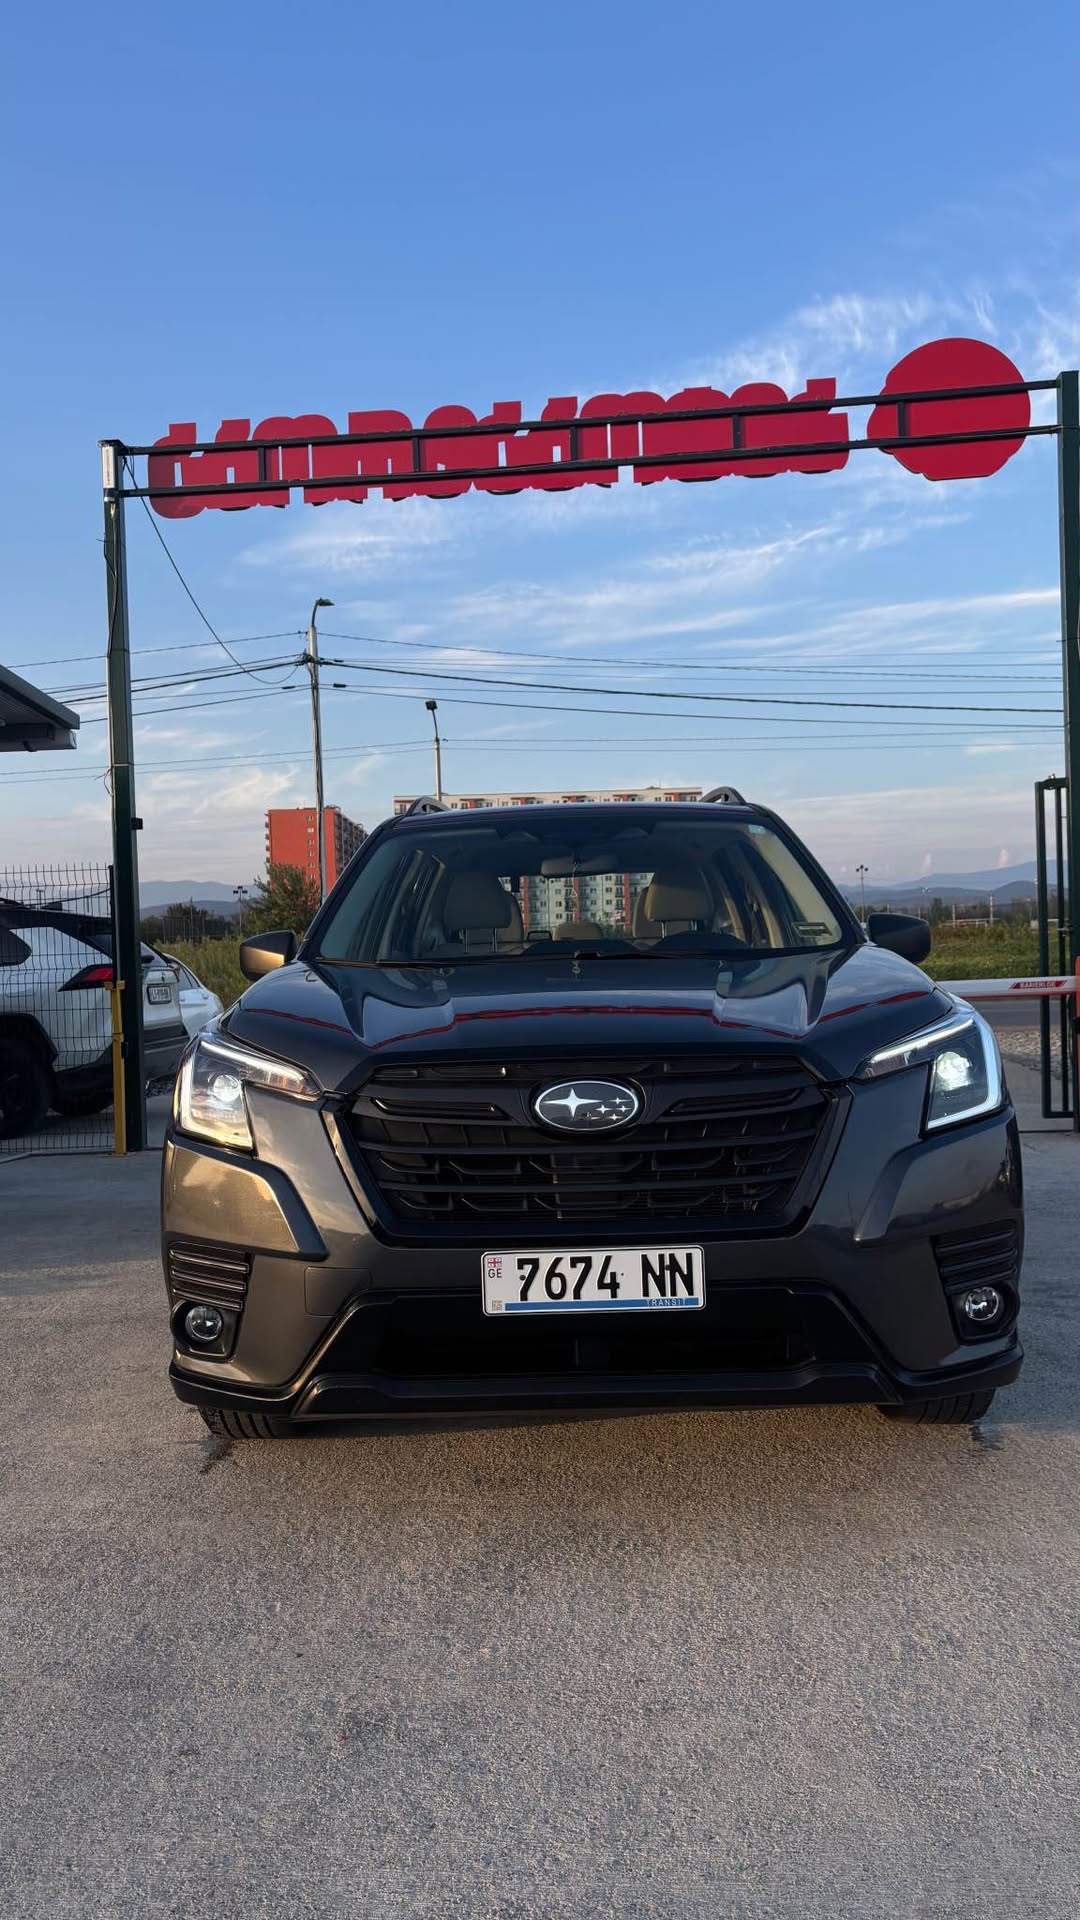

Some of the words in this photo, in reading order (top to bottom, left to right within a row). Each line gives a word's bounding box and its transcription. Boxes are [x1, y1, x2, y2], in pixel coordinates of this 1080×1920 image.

[488, 1268, 502, 1278] GE
[517, 1255, 620, 1301] 7674
[641, 1253, 694, 1297] NN
[647, 1298, 686, 1307] TRANSIT
